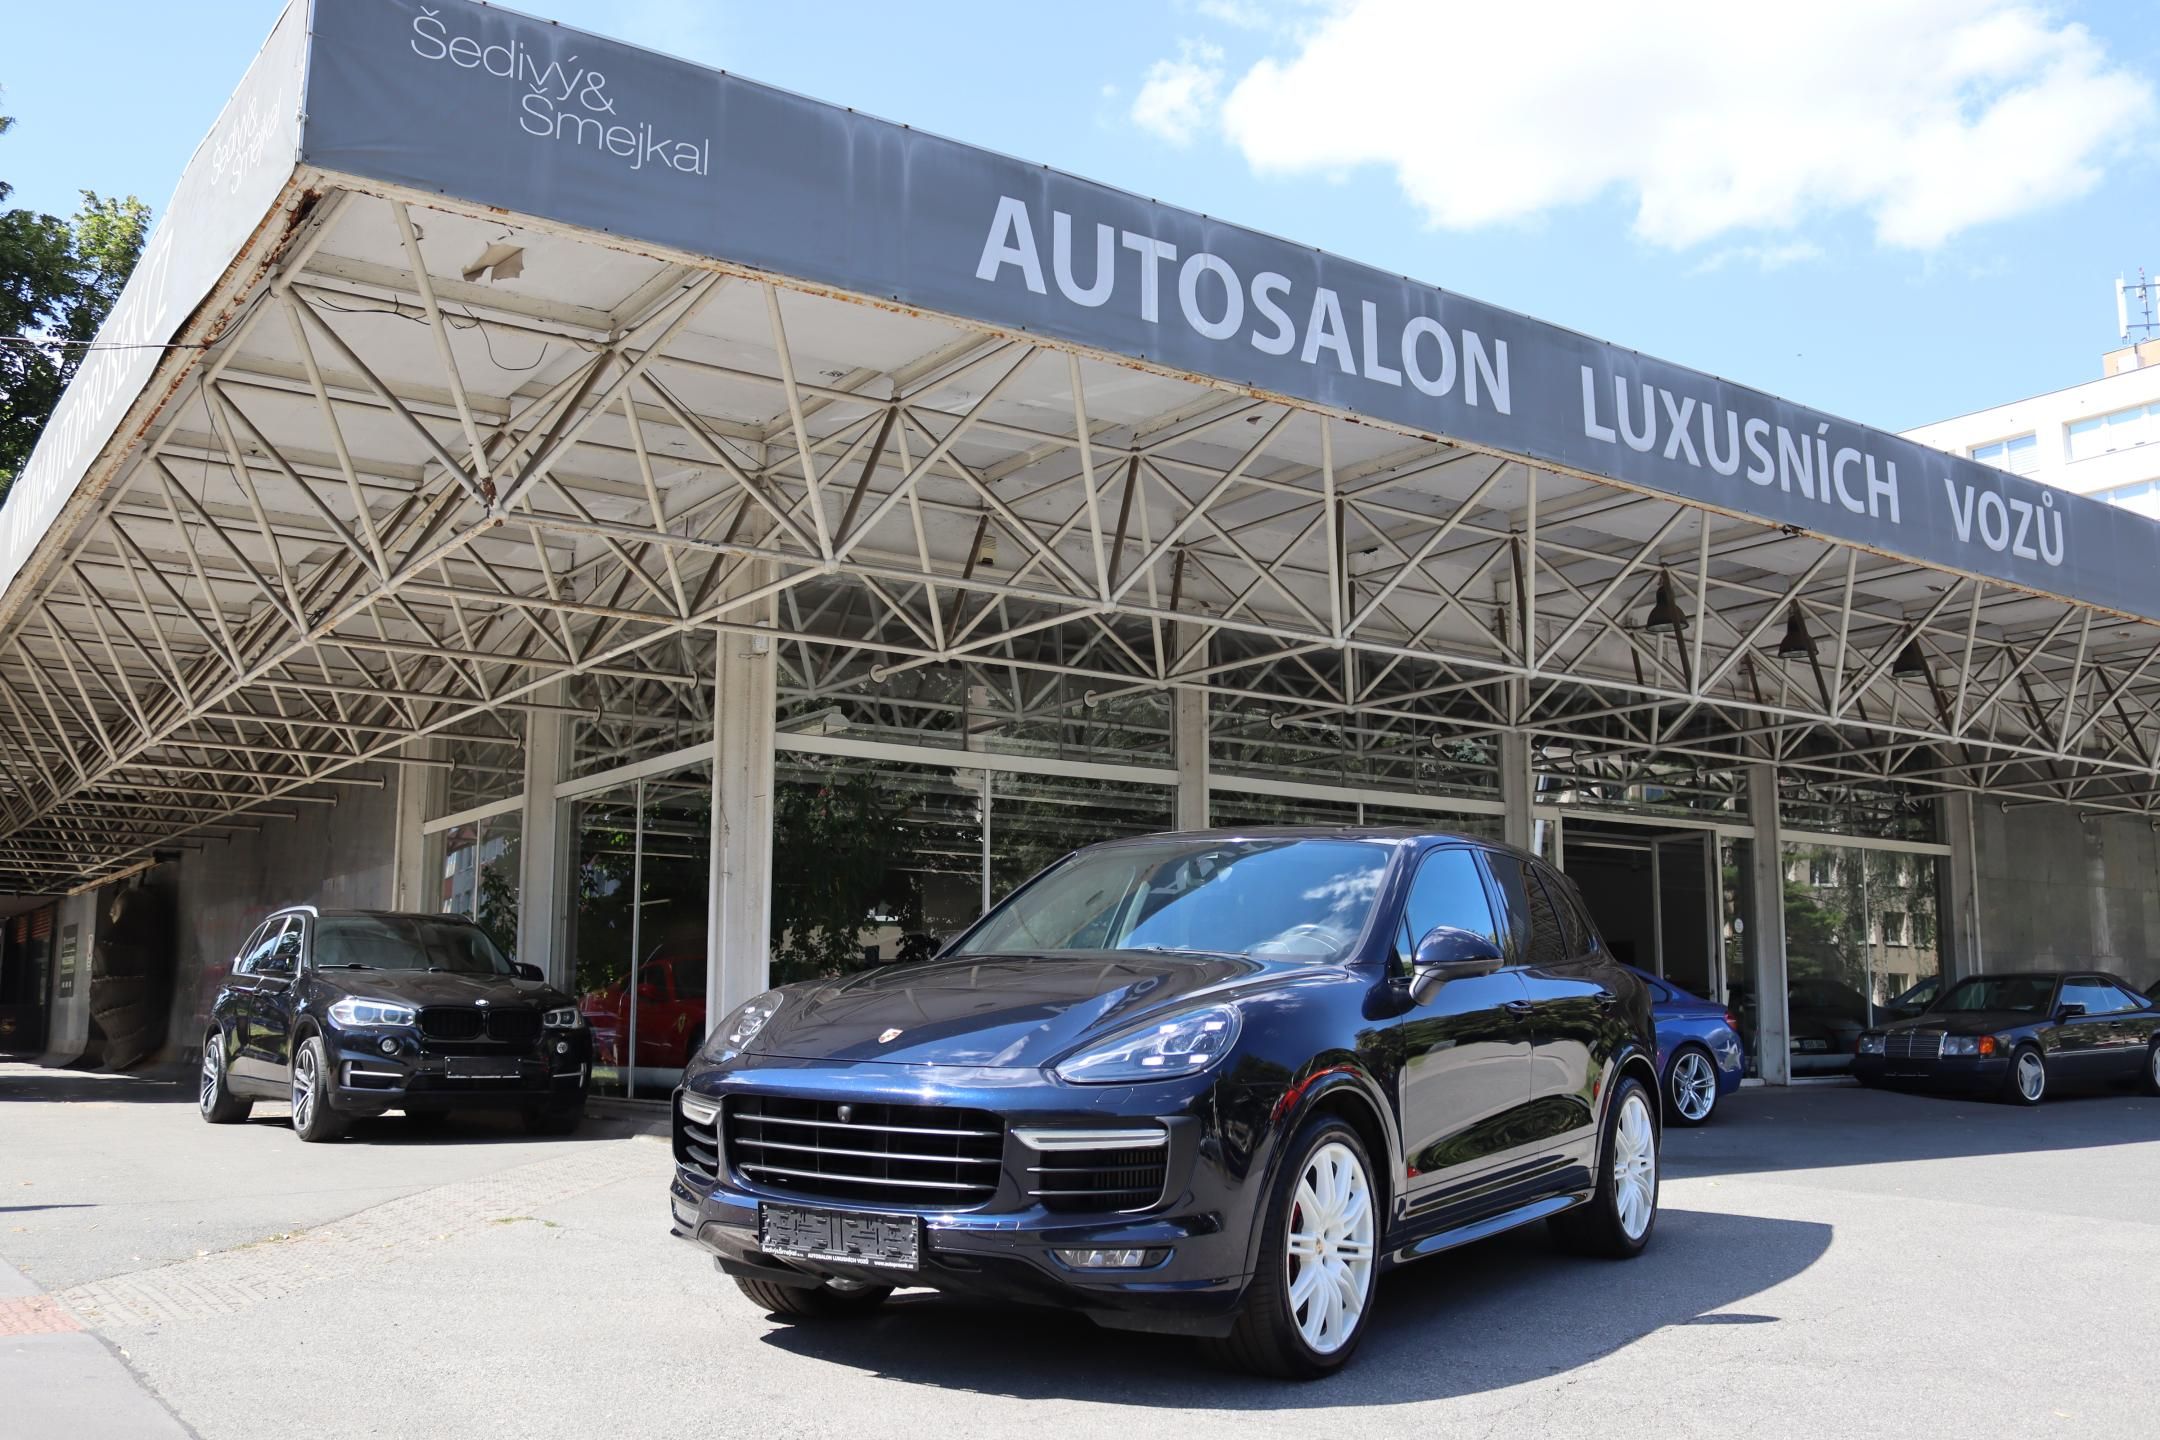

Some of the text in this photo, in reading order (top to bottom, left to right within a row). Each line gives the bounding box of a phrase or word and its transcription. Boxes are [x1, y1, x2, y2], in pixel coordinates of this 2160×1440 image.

[411, 5, 616, 115] Šedivý&
[519, 82, 710, 176] Šmejkal
[975, 195, 2066, 567] AUTOSALON LUXUSNÍCH VOZŮ
